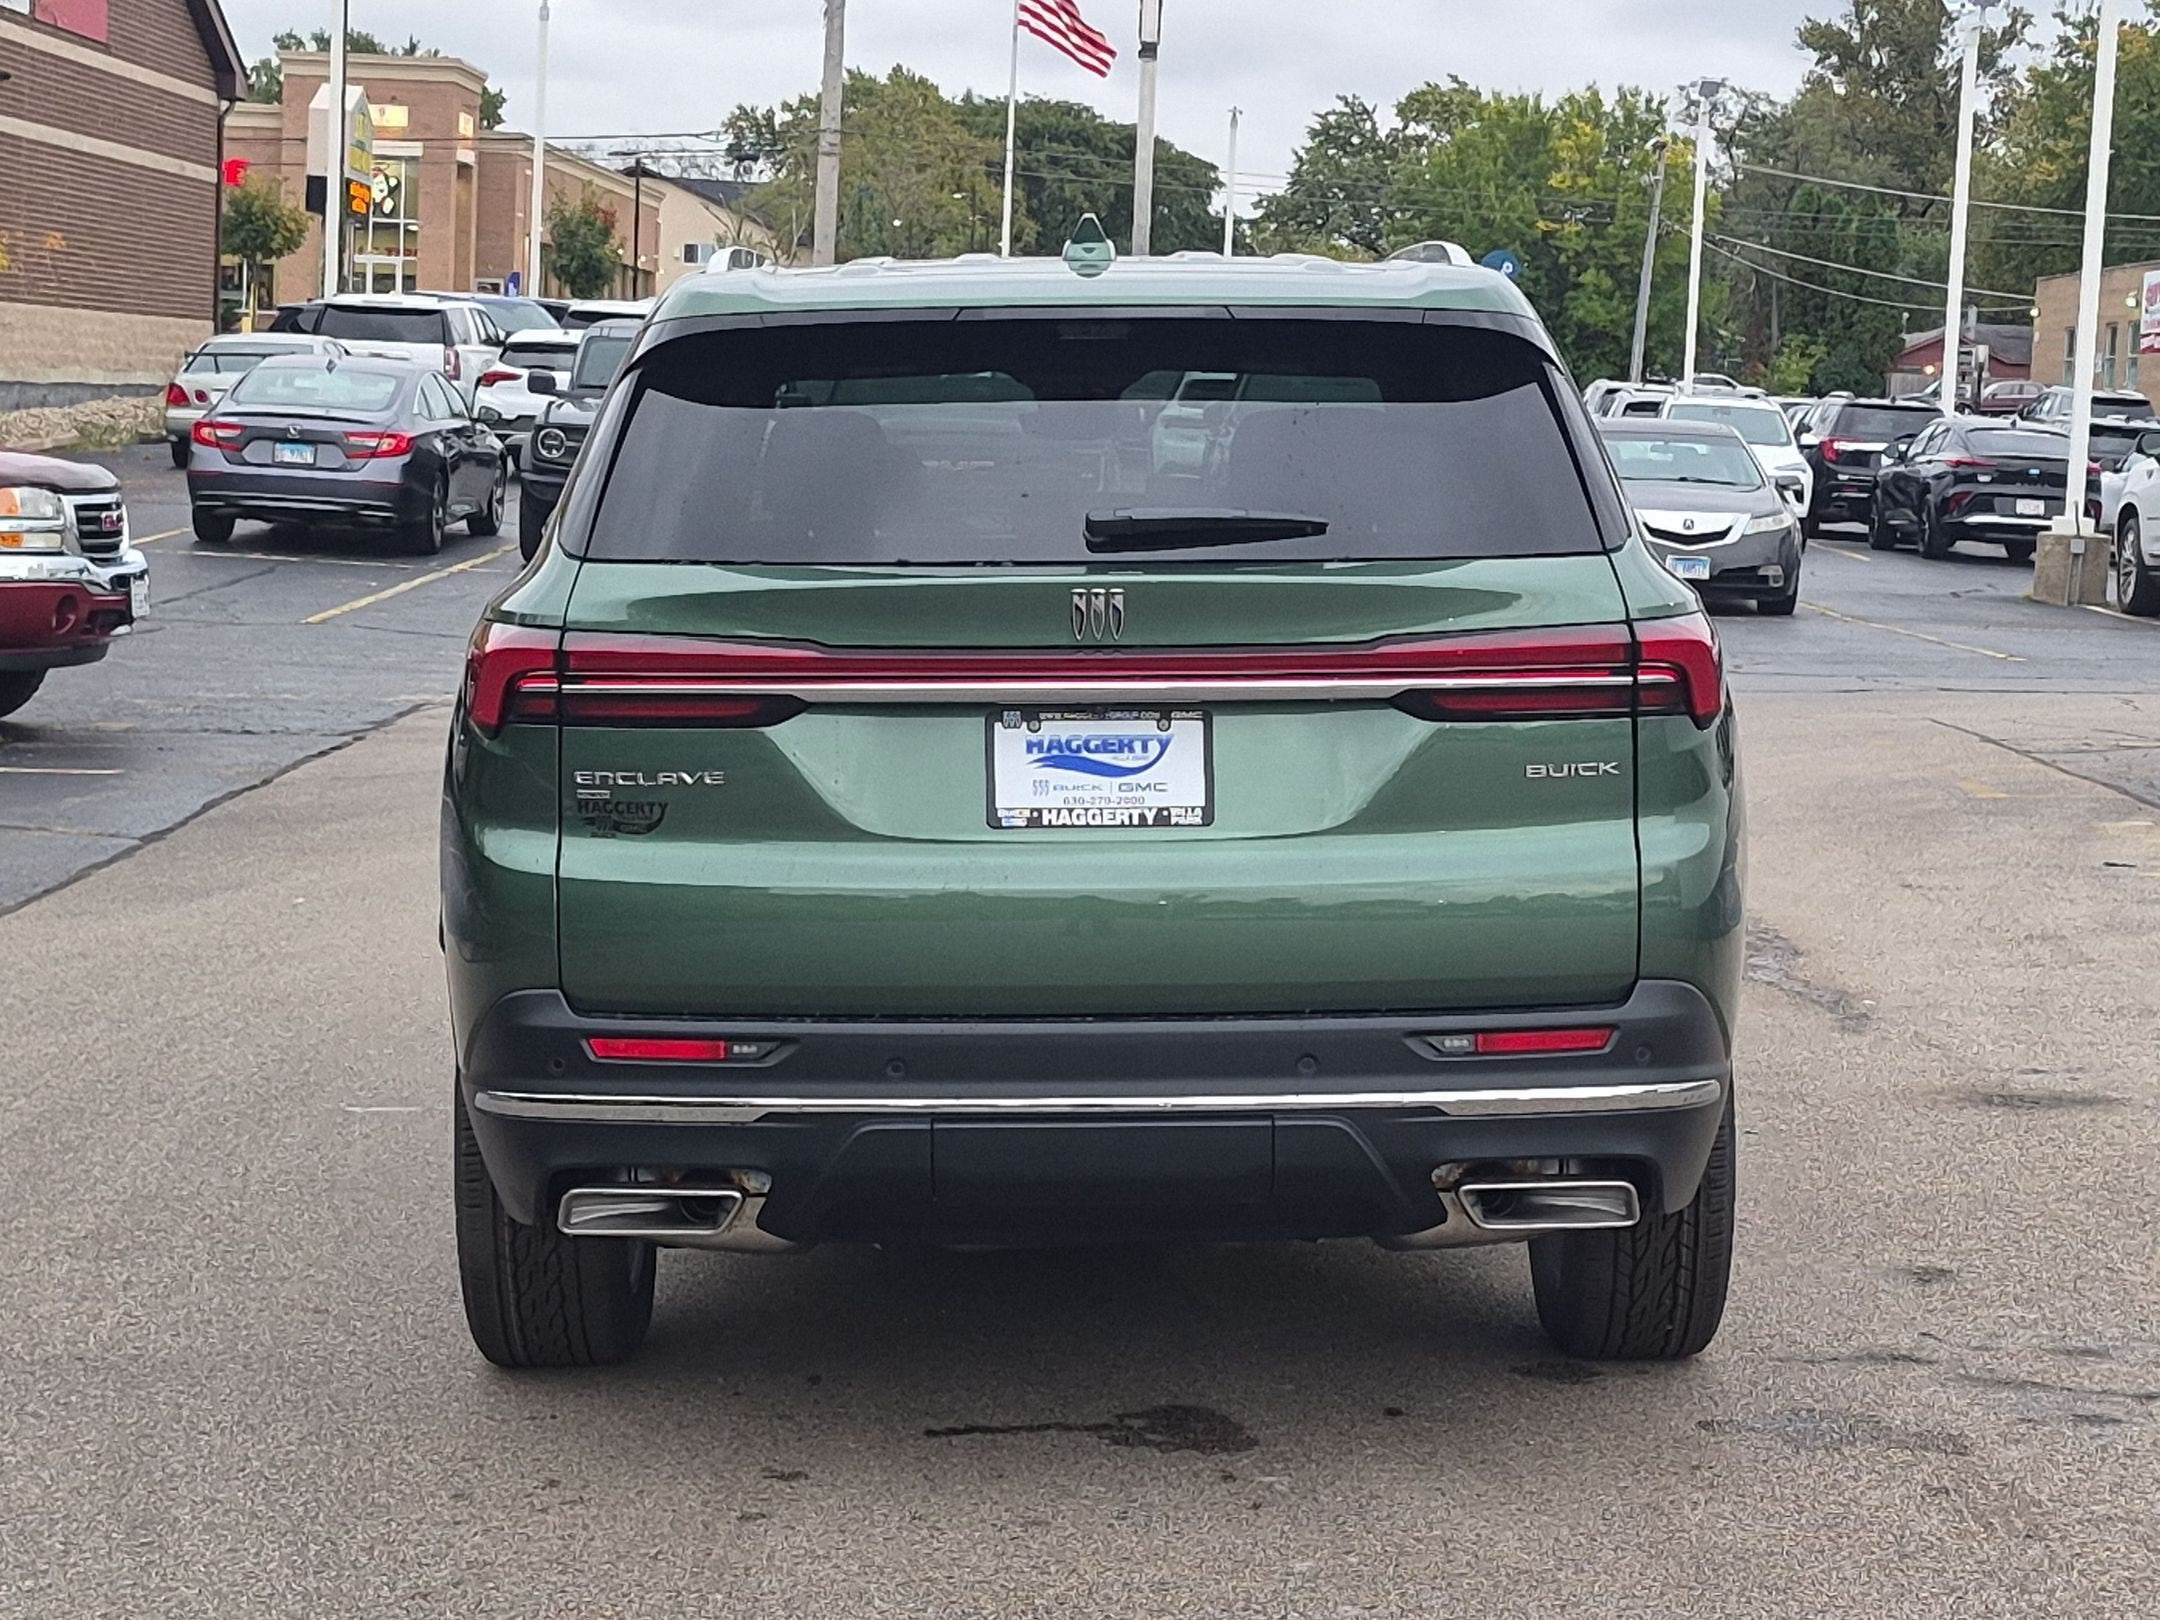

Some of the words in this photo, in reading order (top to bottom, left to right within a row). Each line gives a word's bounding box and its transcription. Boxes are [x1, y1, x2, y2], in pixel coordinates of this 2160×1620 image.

[1025, 734, 1175, 755] HAGGERTY
[1525, 762, 1621, 778] BUICK
[573, 771, 726, 786] ENCLAVE
[1052, 782, 1104, 792] BUICK
[1117, 782, 1169, 793] GMC
[576, 801, 669, 815] HAGGERTY
[1041, 807, 1159, 826] HAGGERTY
